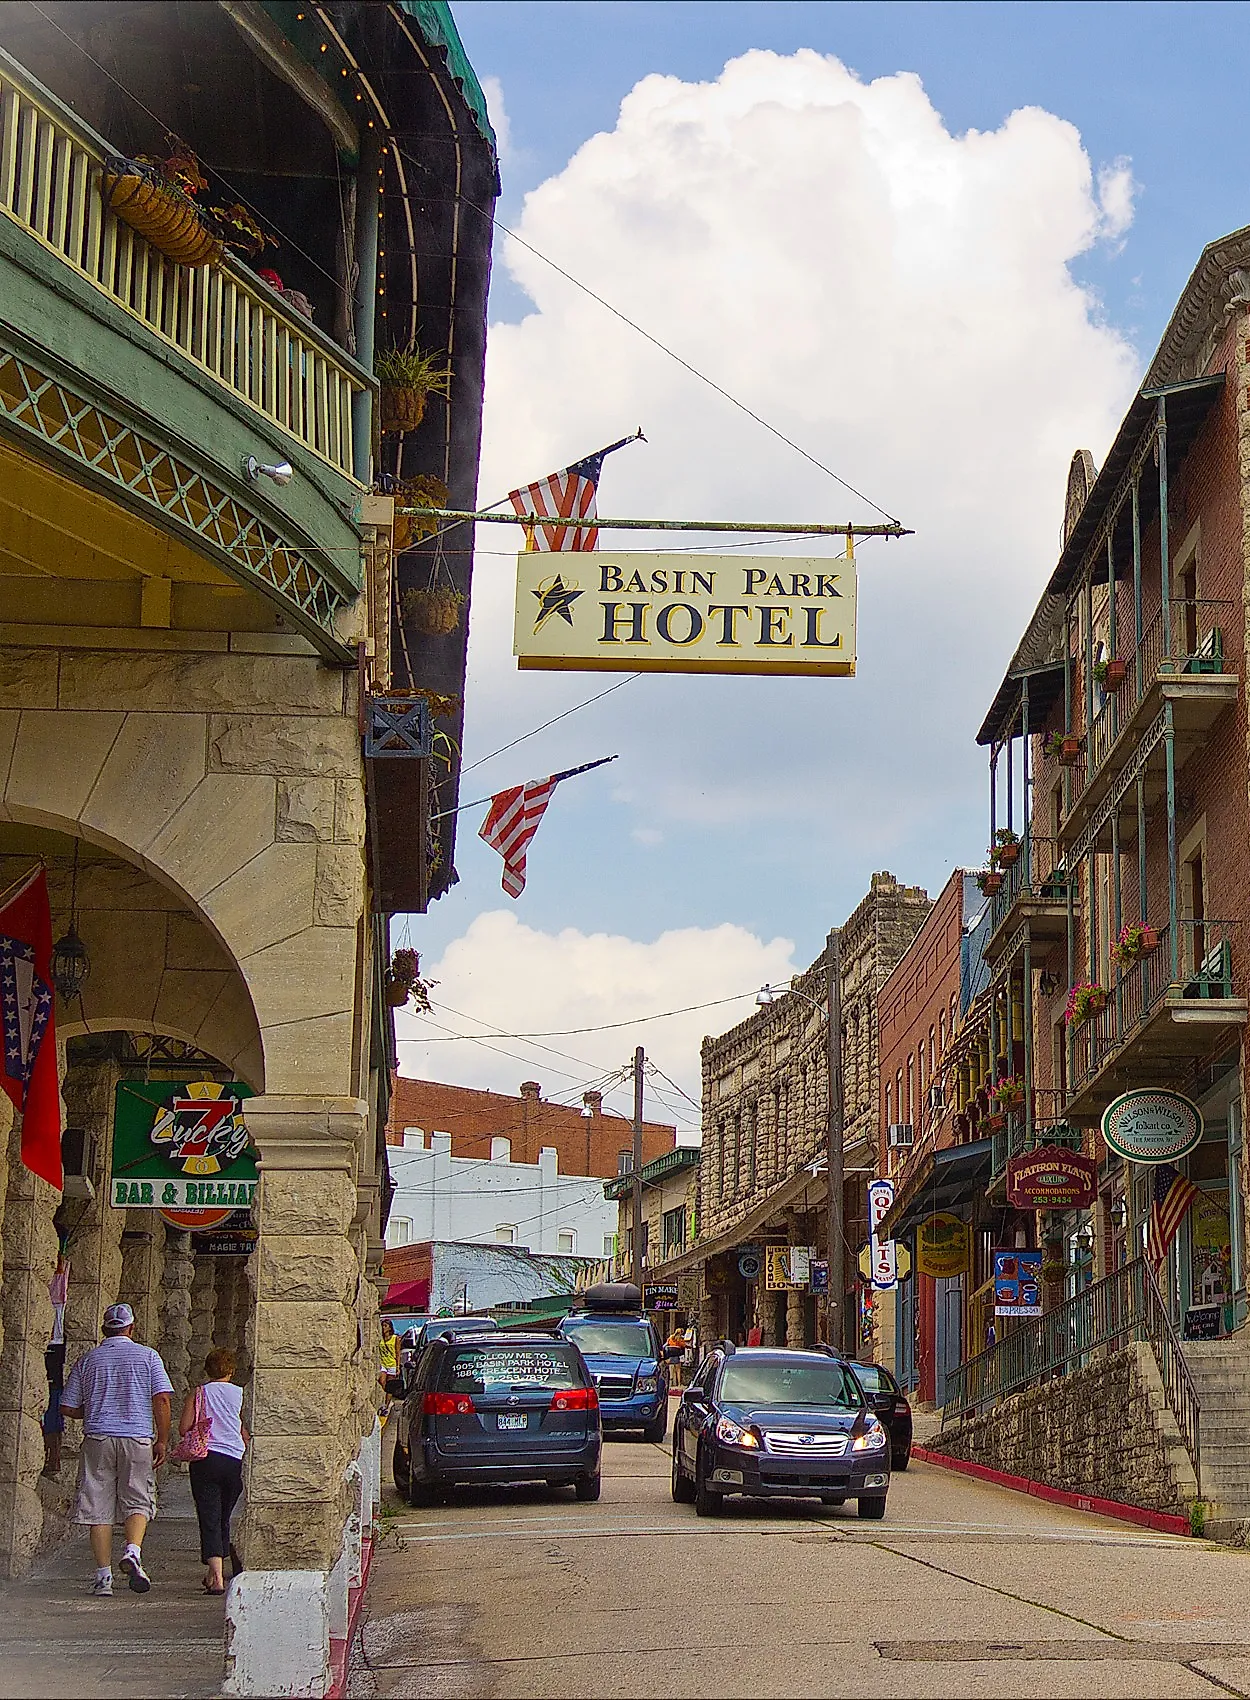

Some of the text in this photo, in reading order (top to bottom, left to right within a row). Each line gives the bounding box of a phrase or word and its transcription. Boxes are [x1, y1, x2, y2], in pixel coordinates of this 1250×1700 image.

[598, 602, 843, 648] HOTEL
[1119, 1107, 1150, 1128] WILSON
[1154, 1105, 1185, 1128] WILSON
[151, 1111, 249, 1157] Lucky
[174, 1099, 236, 1157] 7
[1013, 1162, 1092, 1191] FLATIRON FLATS
[115, 1183, 153, 1204] BAR
[162, 1183, 177, 1204] &
[658, 1286, 678, 1294] MAKE
[452, 1363, 474, 1371] 1905
[476, 1360, 506, 1369] BASIN
[537, 1360, 569, 1369] HOTEL
[474, 1353, 514, 1361] FOLLOW
[456, 1369, 478, 1378] 1886
[480, 1366, 532, 1375] CRESCENT
